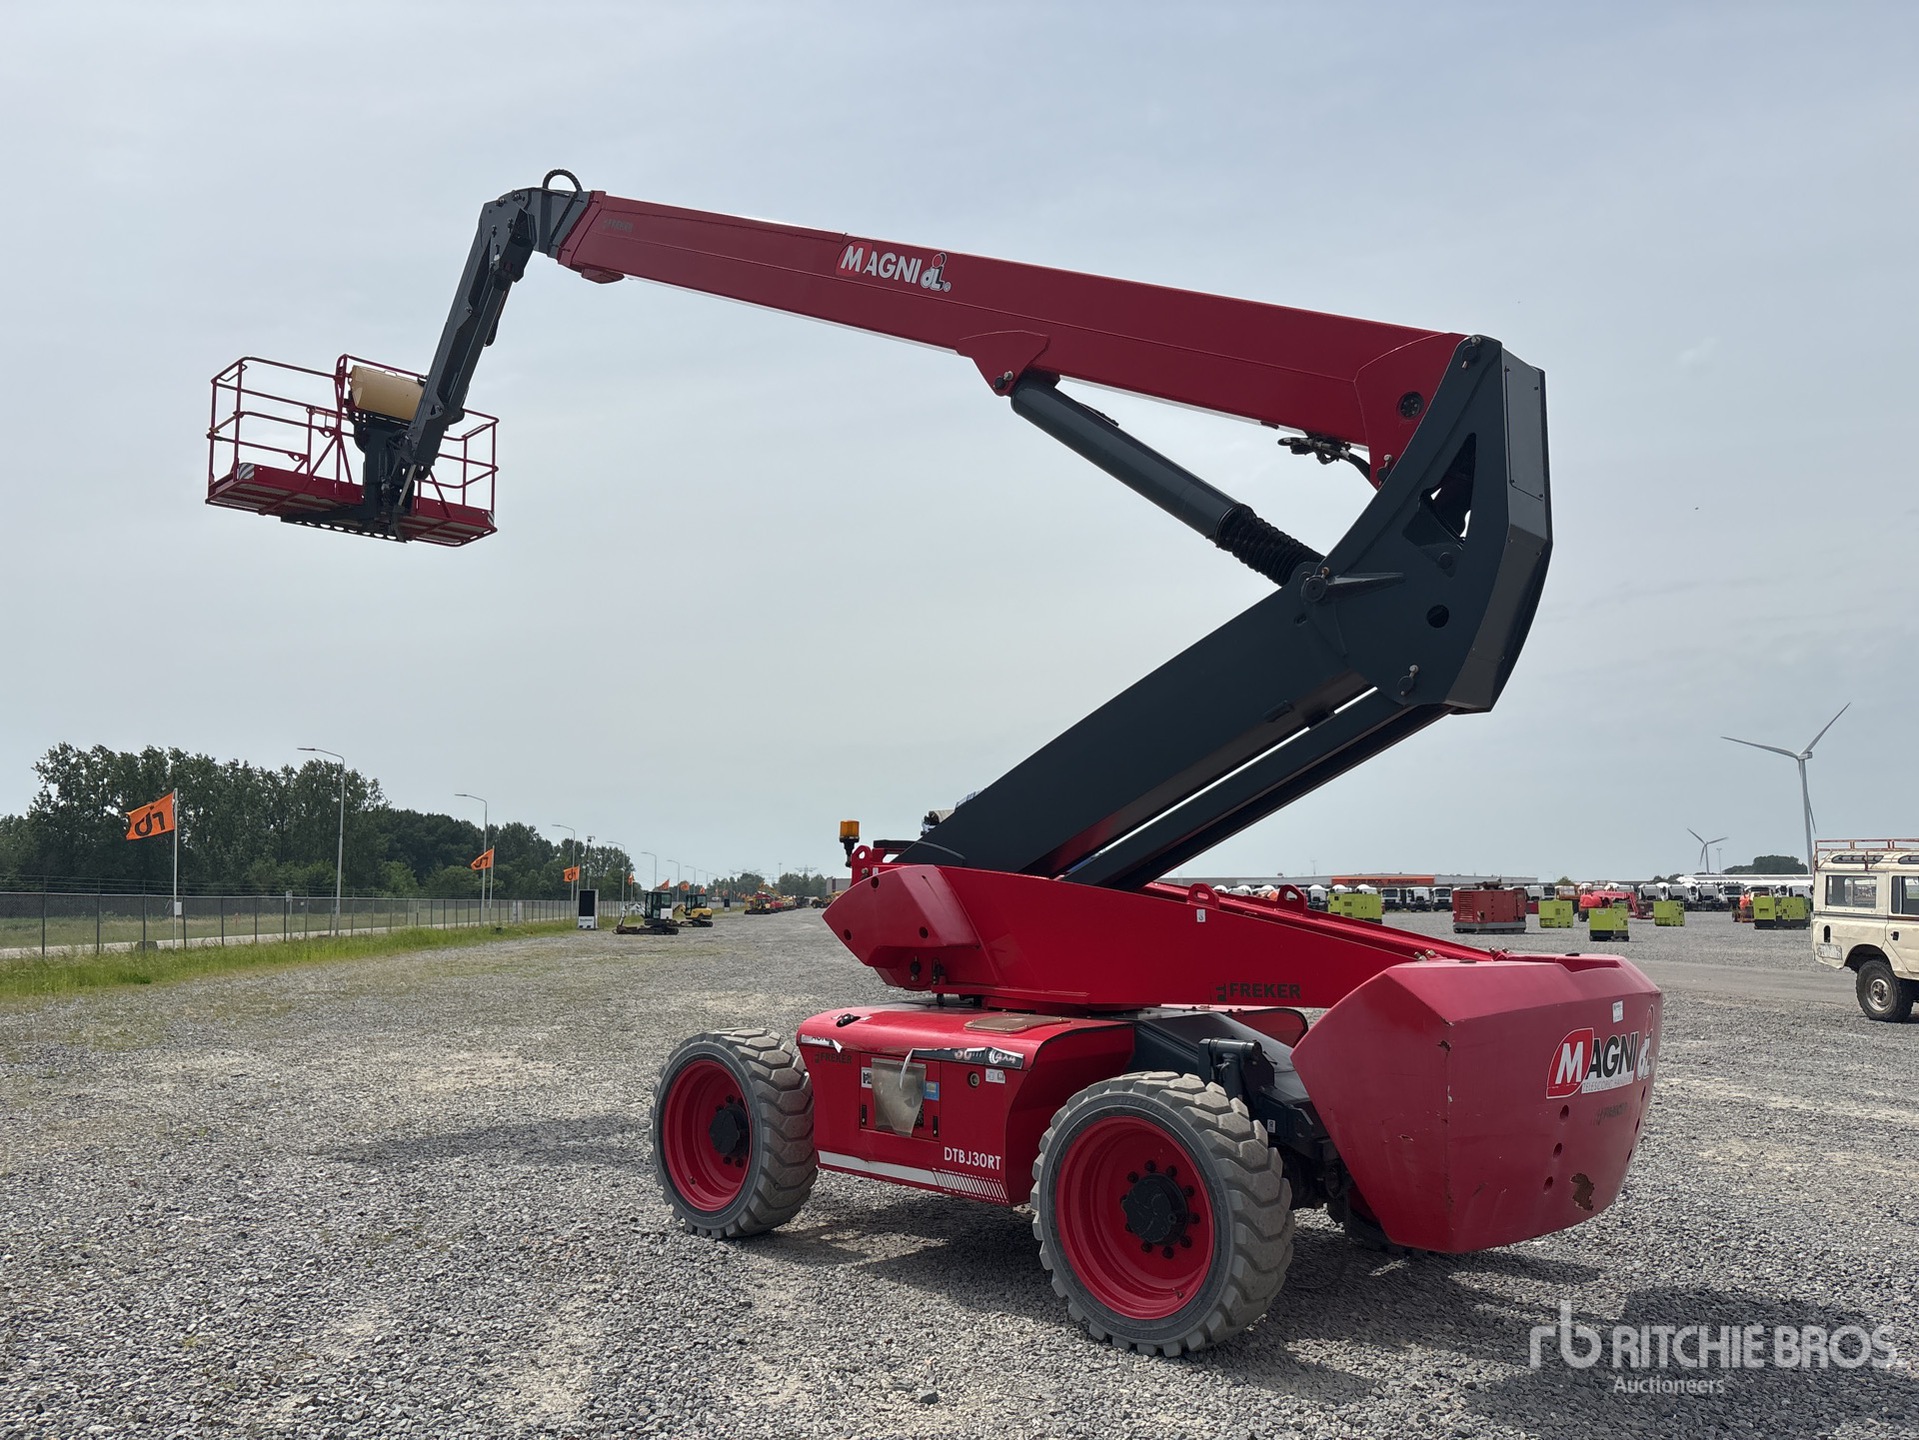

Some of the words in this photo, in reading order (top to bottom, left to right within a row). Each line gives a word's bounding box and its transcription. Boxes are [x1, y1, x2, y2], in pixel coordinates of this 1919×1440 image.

[840, 245, 923, 284] MAGNI
[1555, 1032, 1639, 1084] MAGNI
[943, 1146, 1002, 1170] DTBJ30RT
